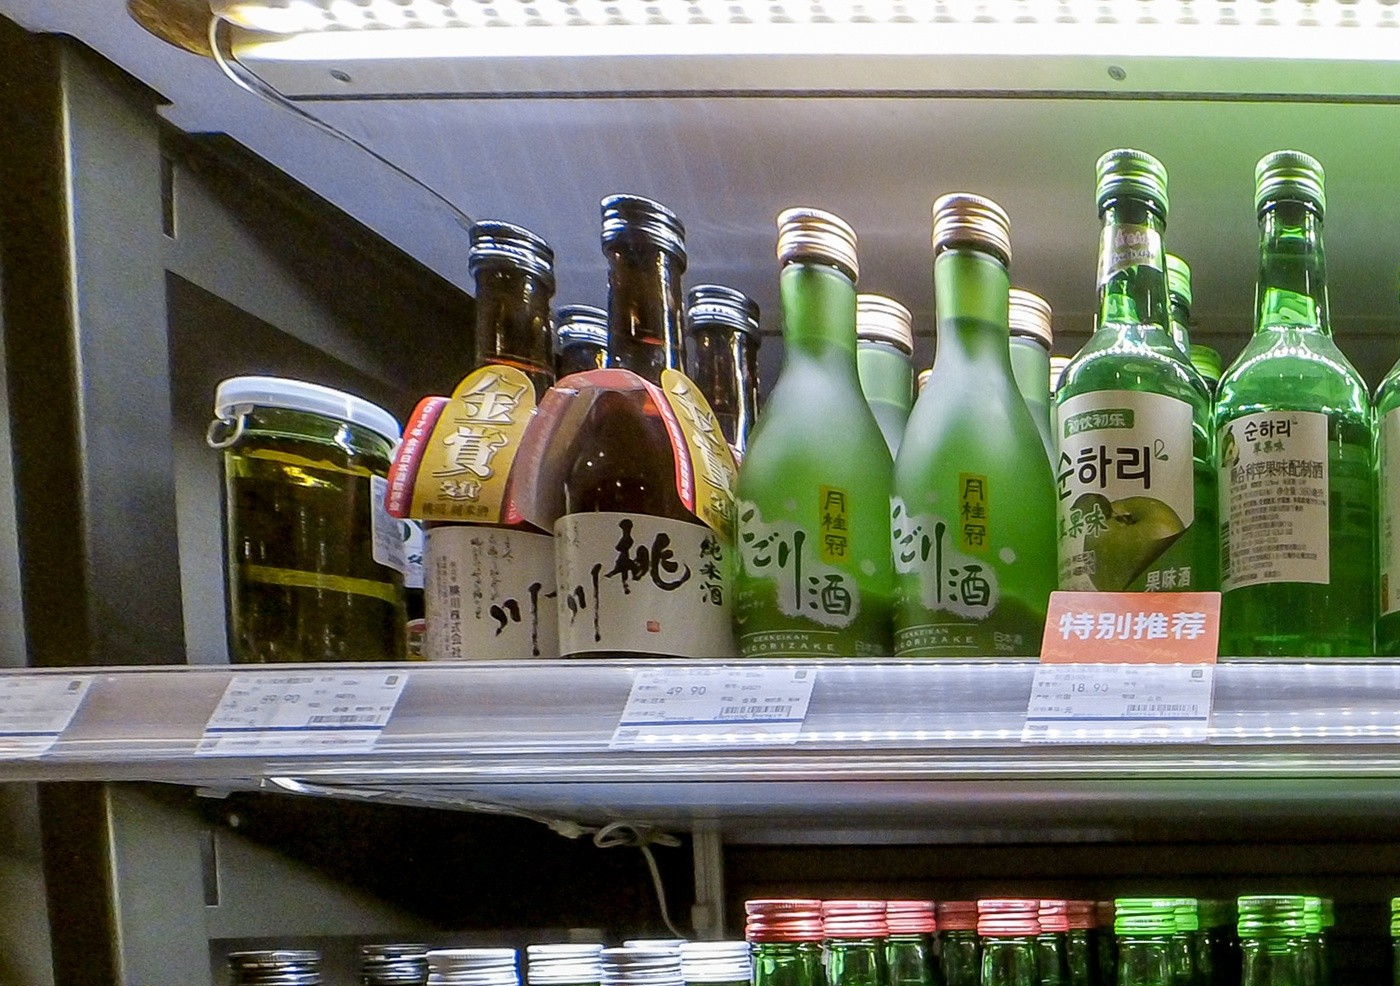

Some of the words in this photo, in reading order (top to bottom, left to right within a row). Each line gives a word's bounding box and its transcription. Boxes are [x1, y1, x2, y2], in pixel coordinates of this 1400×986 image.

[432, 371, 528, 478] 金賞
[1068, 412, 1126, 434] 初饮初乐
[1244, 419, 1291, 441] 순하리
[1057, 445, 1150, 500] 순하리
[823, 490, 848, 557] 月桂冠
[961, 479, 985, 546] 月桂冠
[700, 538, 722, 606] 純米酒
[1146, 566, 1191, 592] 果味酒
[490, 582, 557, 656] 川
[1059, 612, 1207, 641] 特别推荐
